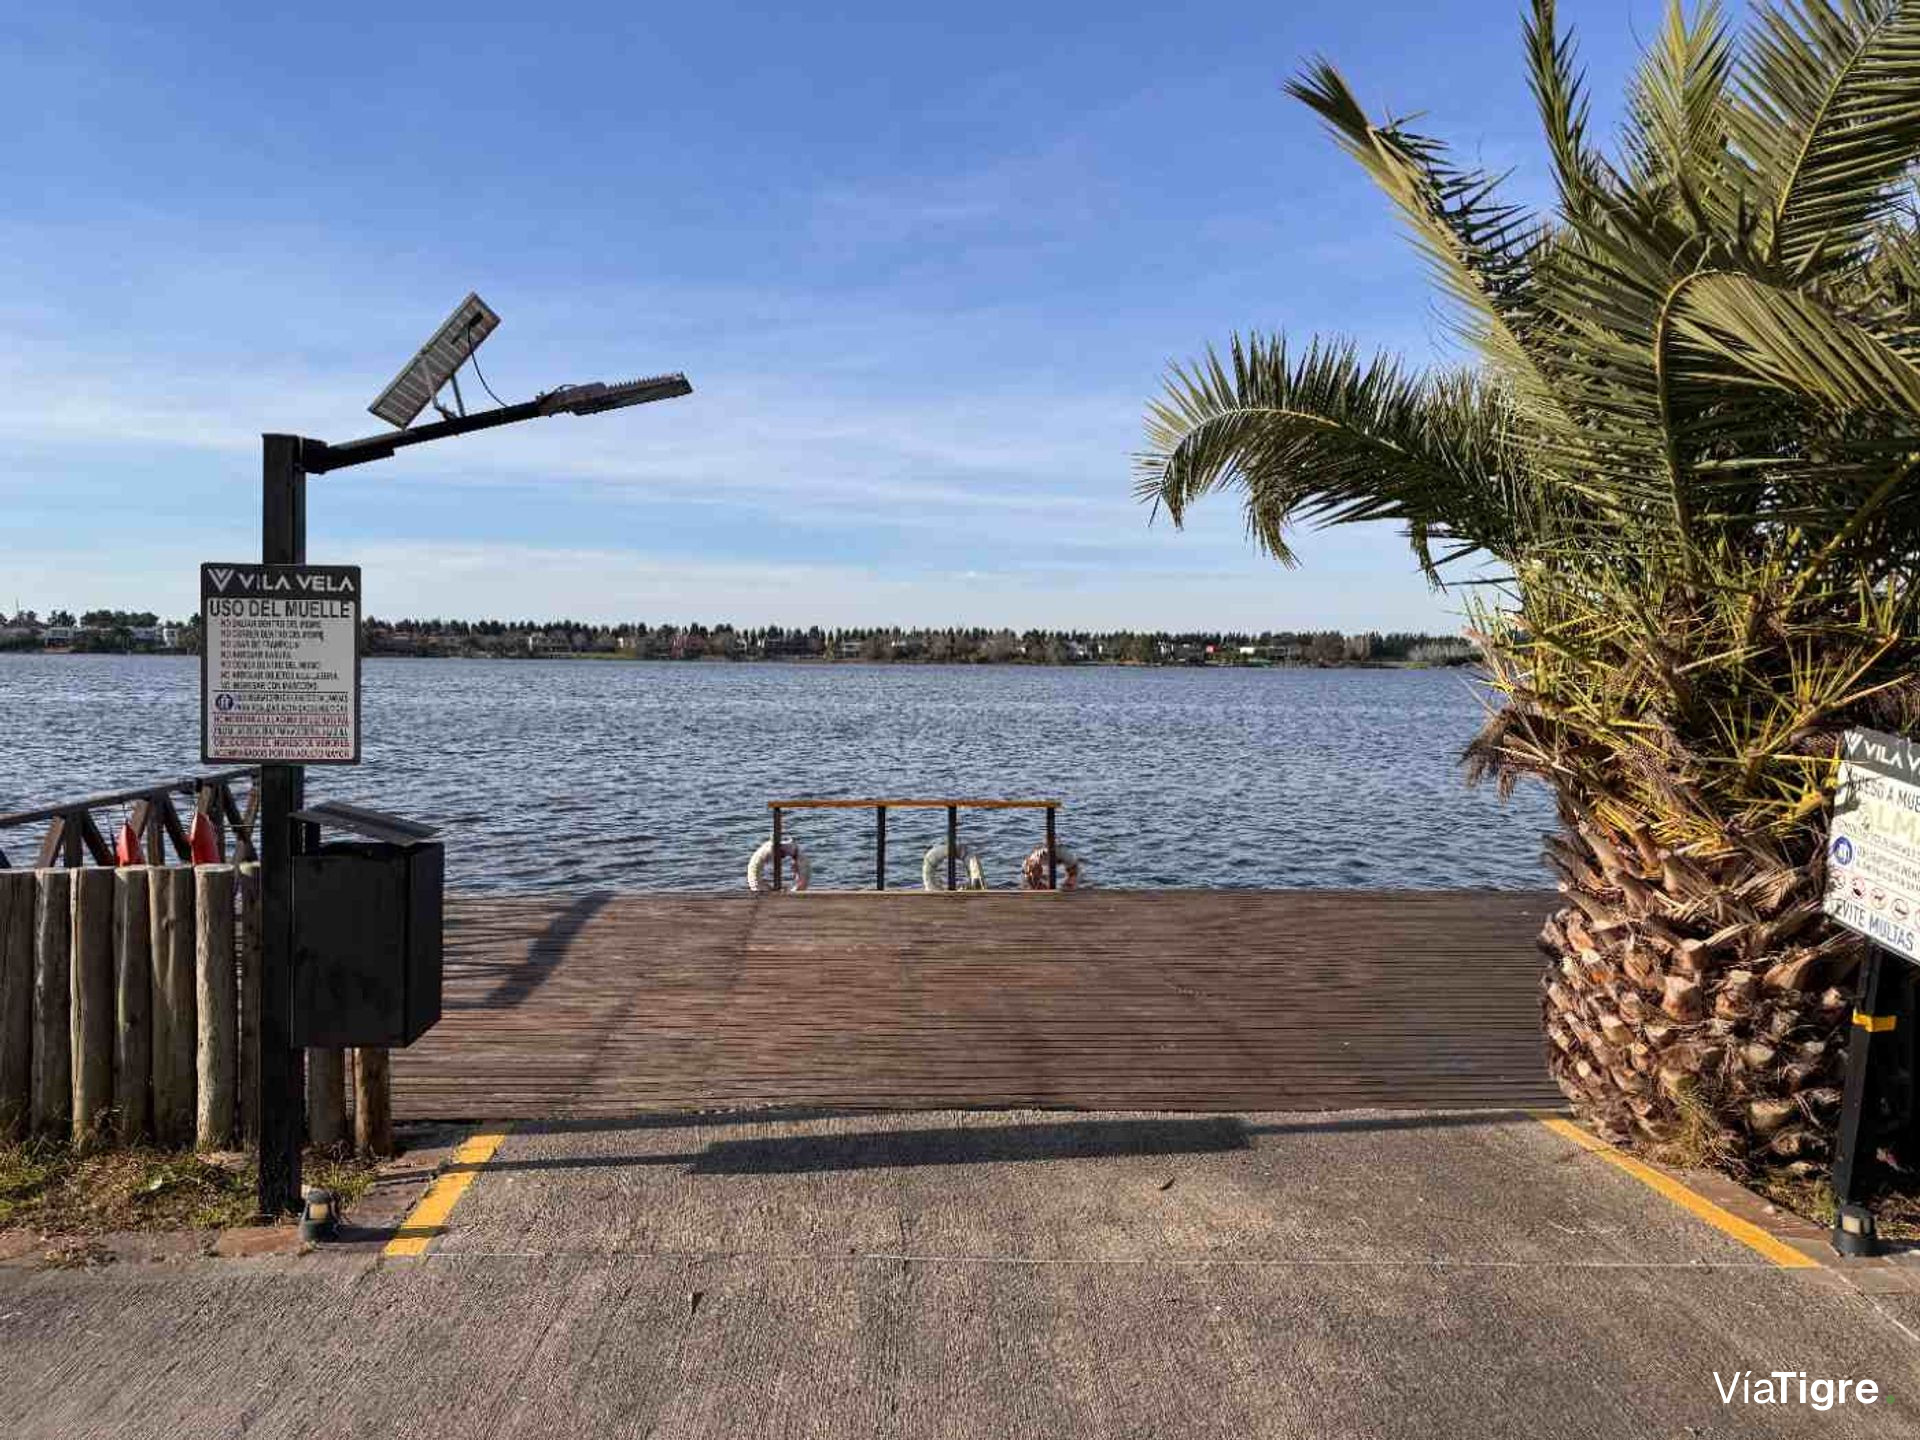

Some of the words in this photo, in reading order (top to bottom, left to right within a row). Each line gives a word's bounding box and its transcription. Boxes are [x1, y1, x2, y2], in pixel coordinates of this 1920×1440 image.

[238, 573, 291, 590] VILA
[296, 574, 355, 592] VELA
[210, 600, 244, 617] USO
[249, 600, 281, 617] DEL
[286, 601, 350, 618] MUELLE
[1864, 740, 1903, 769] VILA
[1833, 900, 1866, 928] EVITE
[1869, 913, 1914, 951] MULTAS
